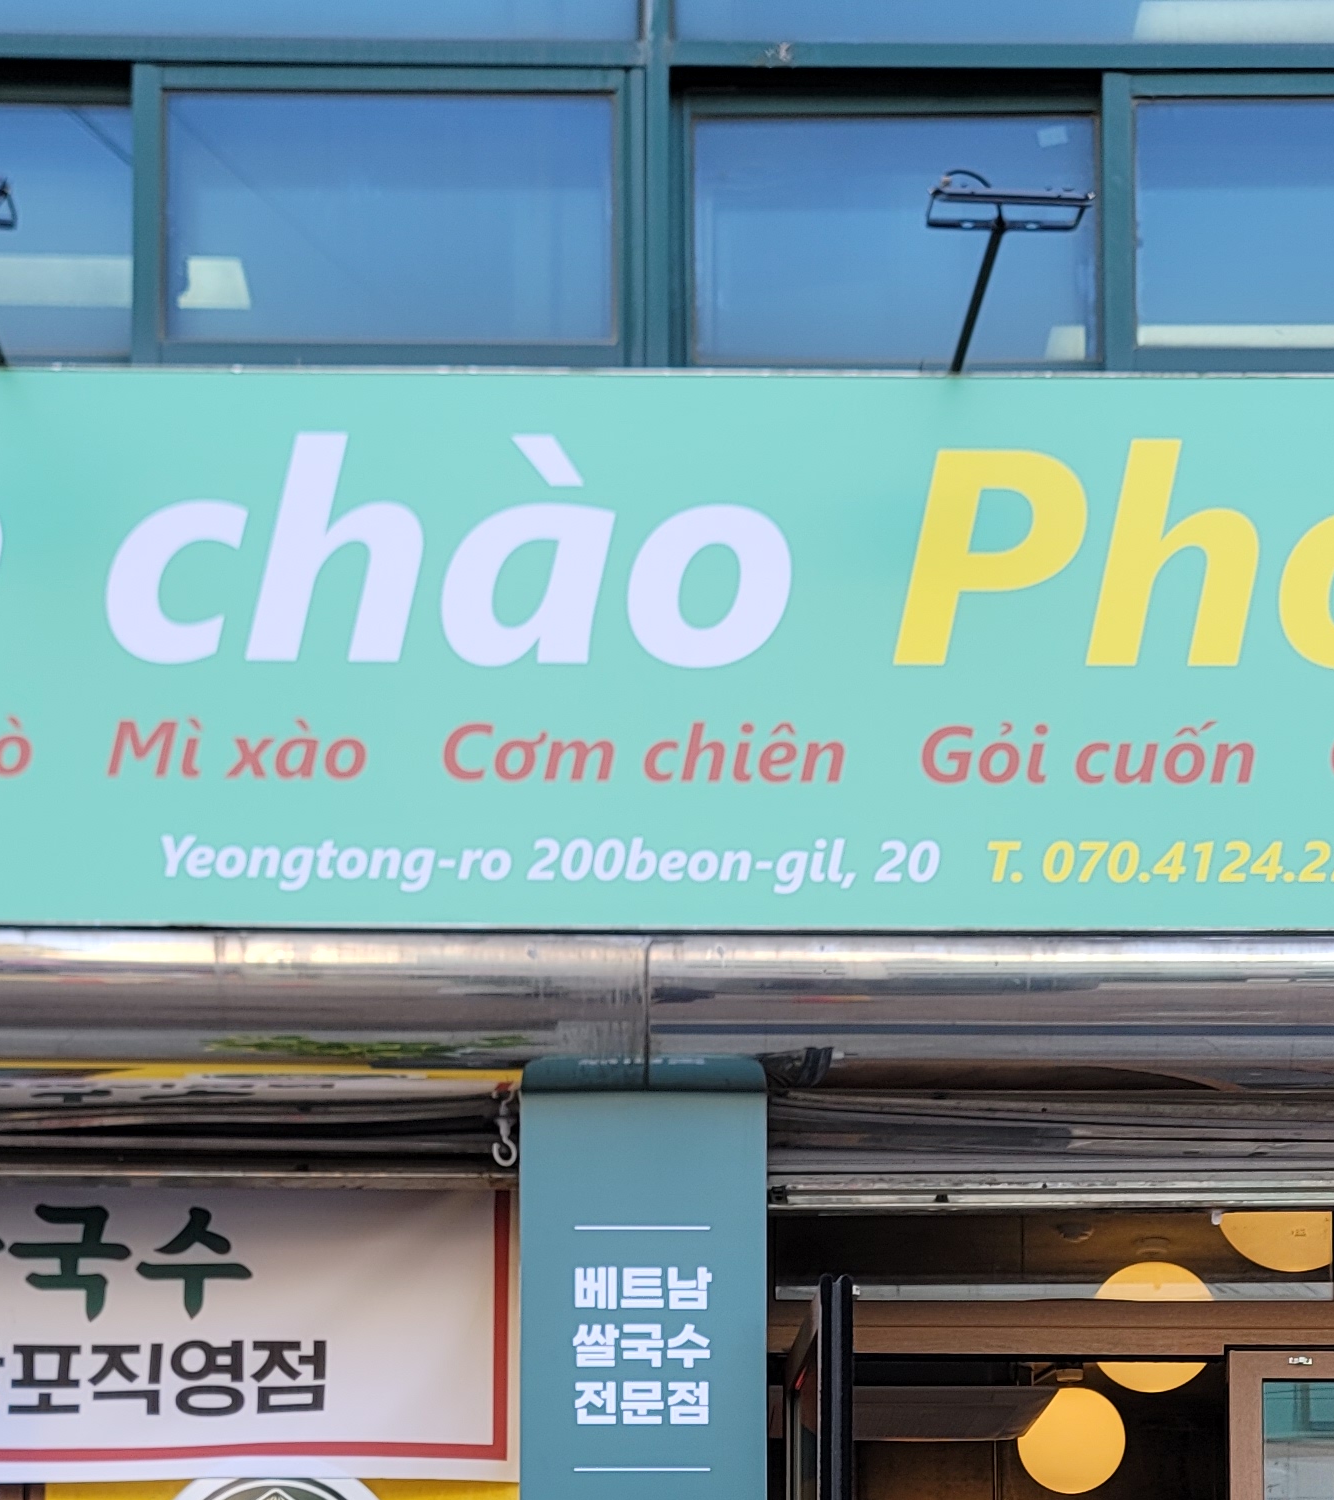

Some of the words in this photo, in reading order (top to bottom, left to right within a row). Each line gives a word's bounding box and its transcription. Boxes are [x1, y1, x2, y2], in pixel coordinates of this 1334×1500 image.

[107, 432, 791, 667] chào
[108, 718, 200, 778] Mì
[227, 719, 366, 780] xào
[443, 723, 615, 781] Cơm
[642, 722, 844, 783] chiên
[921, 722, 1048, 784] Gỏi
[1075, 721, 1254, 784] cuốn
[162, 836, 511, 891] Yeongtong-ro
[527, 838, 855, 894] 200beon-gil,
[874, 840, 940, 883] 20
[988, 841, 1022, 883] T.
[574, 1266, 713, 1310] 베트남
[572, 1323, 711, 1369] 쌀국수
[574, 1380, 709, 1425] 전문점
